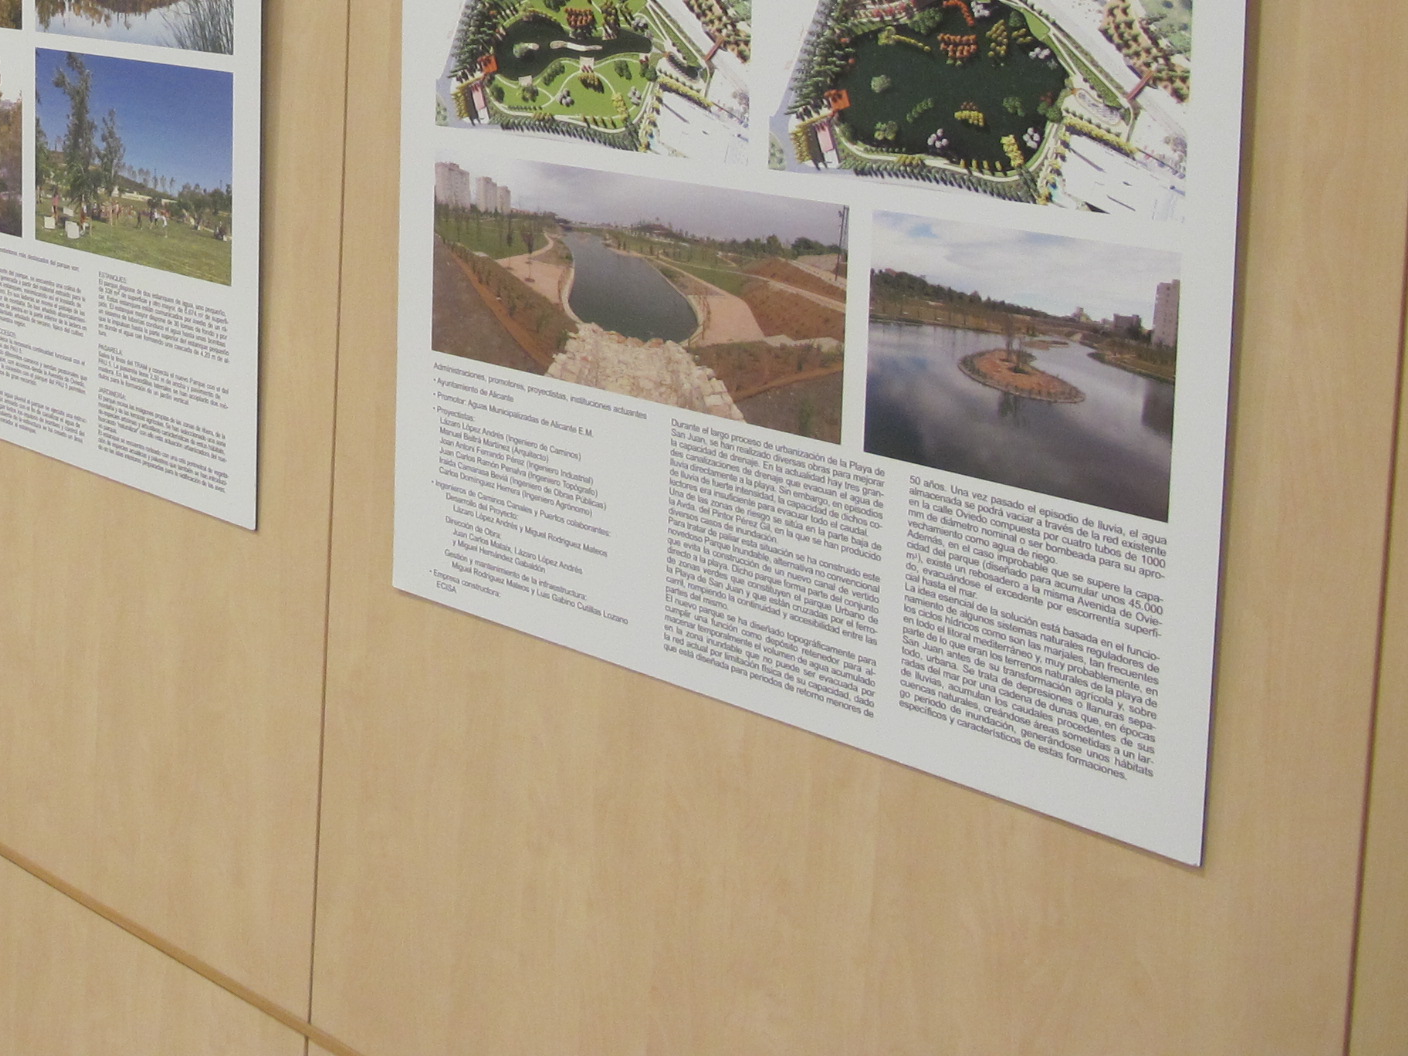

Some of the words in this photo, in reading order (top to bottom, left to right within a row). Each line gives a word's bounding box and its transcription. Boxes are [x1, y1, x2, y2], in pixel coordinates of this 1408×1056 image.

[434, 362, 486, 381] Administraciones,
[489, 376, 526, 392] promotores,
[528, 385, 568, 402] proyectistas,
[570, 396, 611, 412] instituciones
[613, 405, 647, 419] actuantes
[437, 378, 478, 394] Ayuntamiento
[480, 387, 488, 396] de
[490, 390, 514, 402] Alicante
[437, 392, 466, 406] Promotor:
[468, 401, 487, 412] Aguas
[489, 406, 539, 424] Municipalizadas
[541, 418, 549, 426] de
[551, 420, 577, 434] Alicante
[579, 427, 594, 437] E.M.
[671, 418, 700, 433] Durante
[702, 426, 708, 434] el
[711, 428, 729, 441] largo
[731, 433, 761, 448] proceso
[763, 441, 773, 450] de
[775, 444, 825, 462] urbanización
[827, 456, 837, 465] de
[840, 459, 847, 468] la
[850, 461, 872, 475] Playa
[874, 468, 885, 477] de
[910, 476, 921, 486] 50
[924, 479, 946, 491] años.
[951, 485, 969, 497] Una
[971, 492, 987, 502] vez
[991, 495, 1024, 511] pasado
[1027, 504, 1036, 513] el
[1039, 507, 1078, 524] episodio
[1082, 517, 1094, 527] de
[1098, 521, 1125, 536] lluvia,
[1129, 529, 1138, 538] el
[1142, 532, 1167, 546] agua
